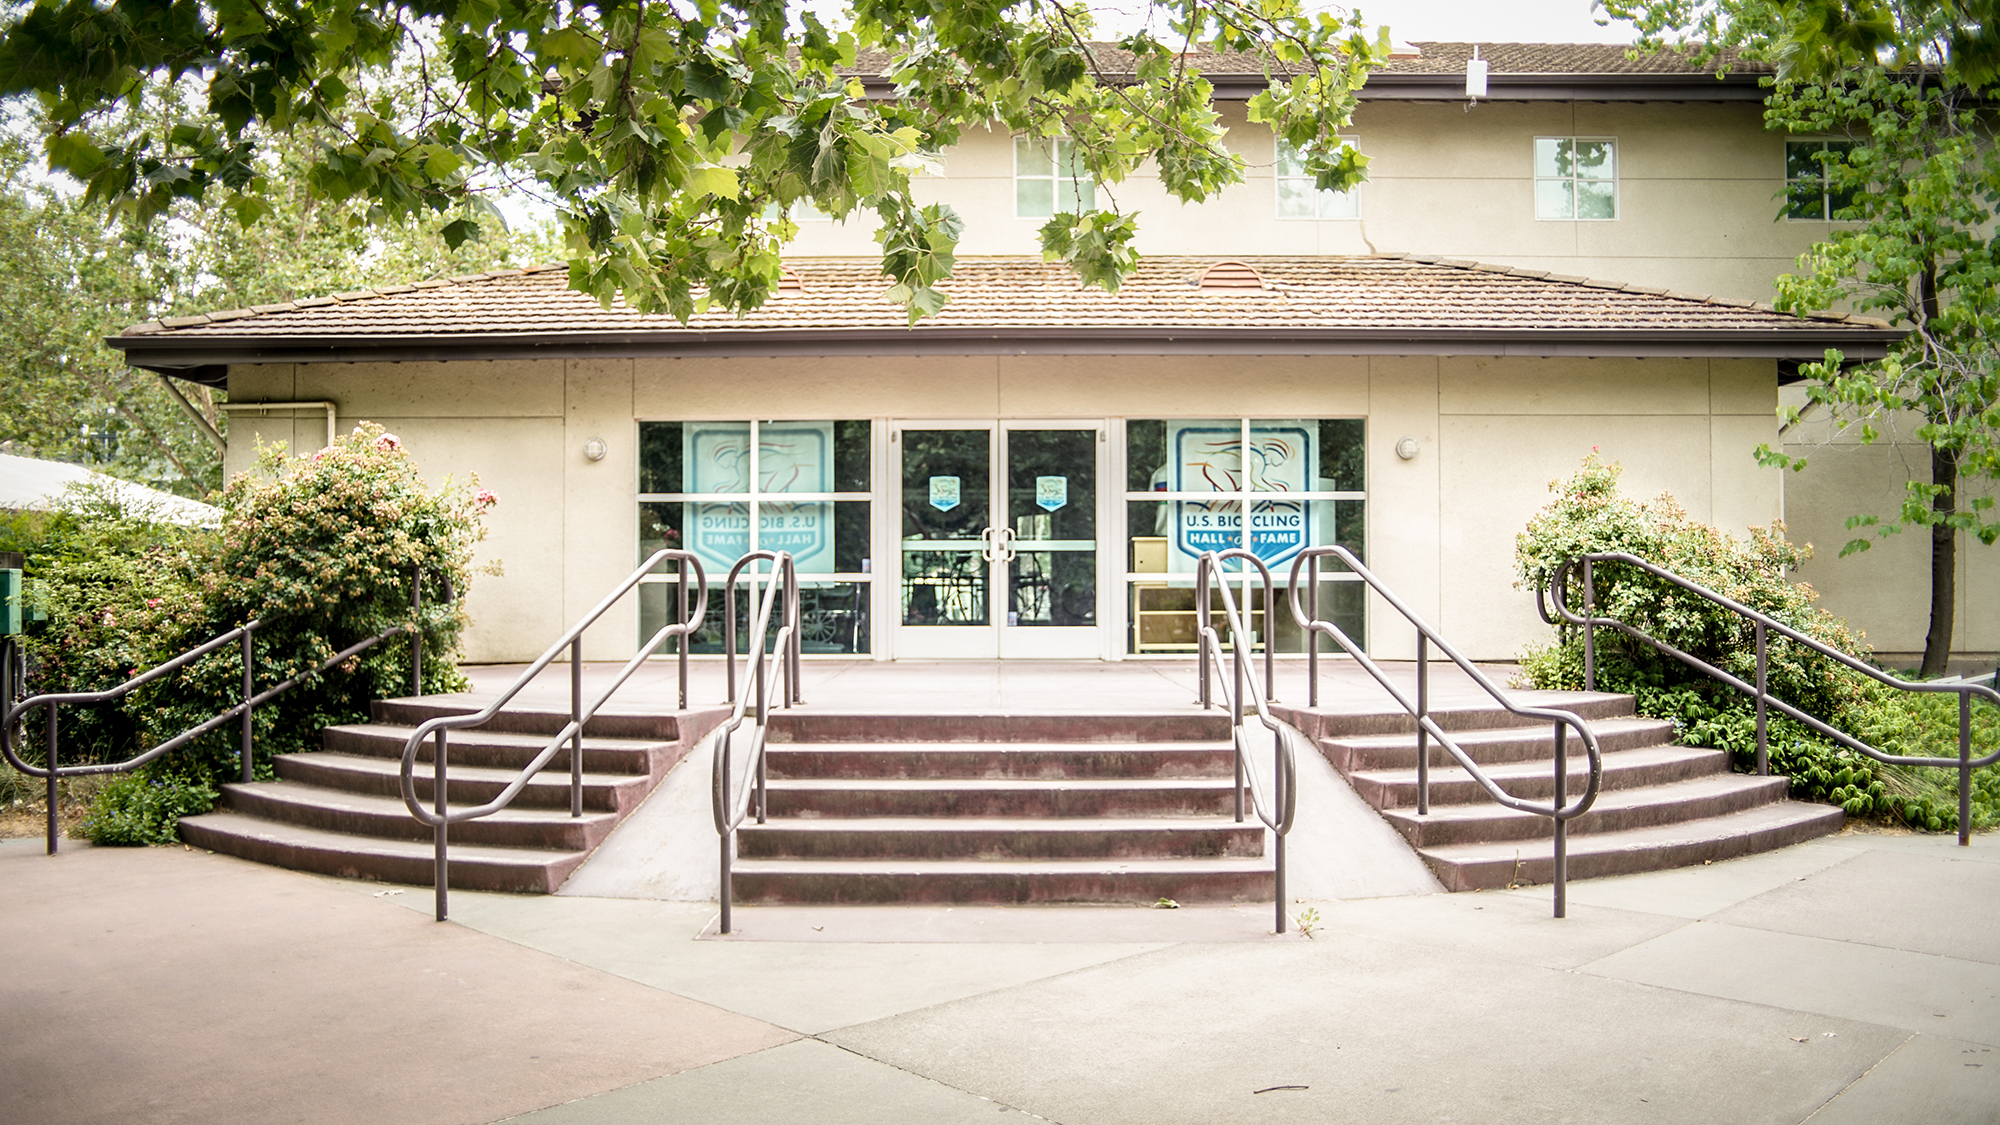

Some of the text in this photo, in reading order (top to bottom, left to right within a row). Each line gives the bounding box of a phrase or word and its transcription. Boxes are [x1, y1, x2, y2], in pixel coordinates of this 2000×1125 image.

[1186, 515, 1300, 527] U.S. BICCLING
[1190, 532, 1226, 544] HALL
[1260, 532, 1297, 544] FAME
